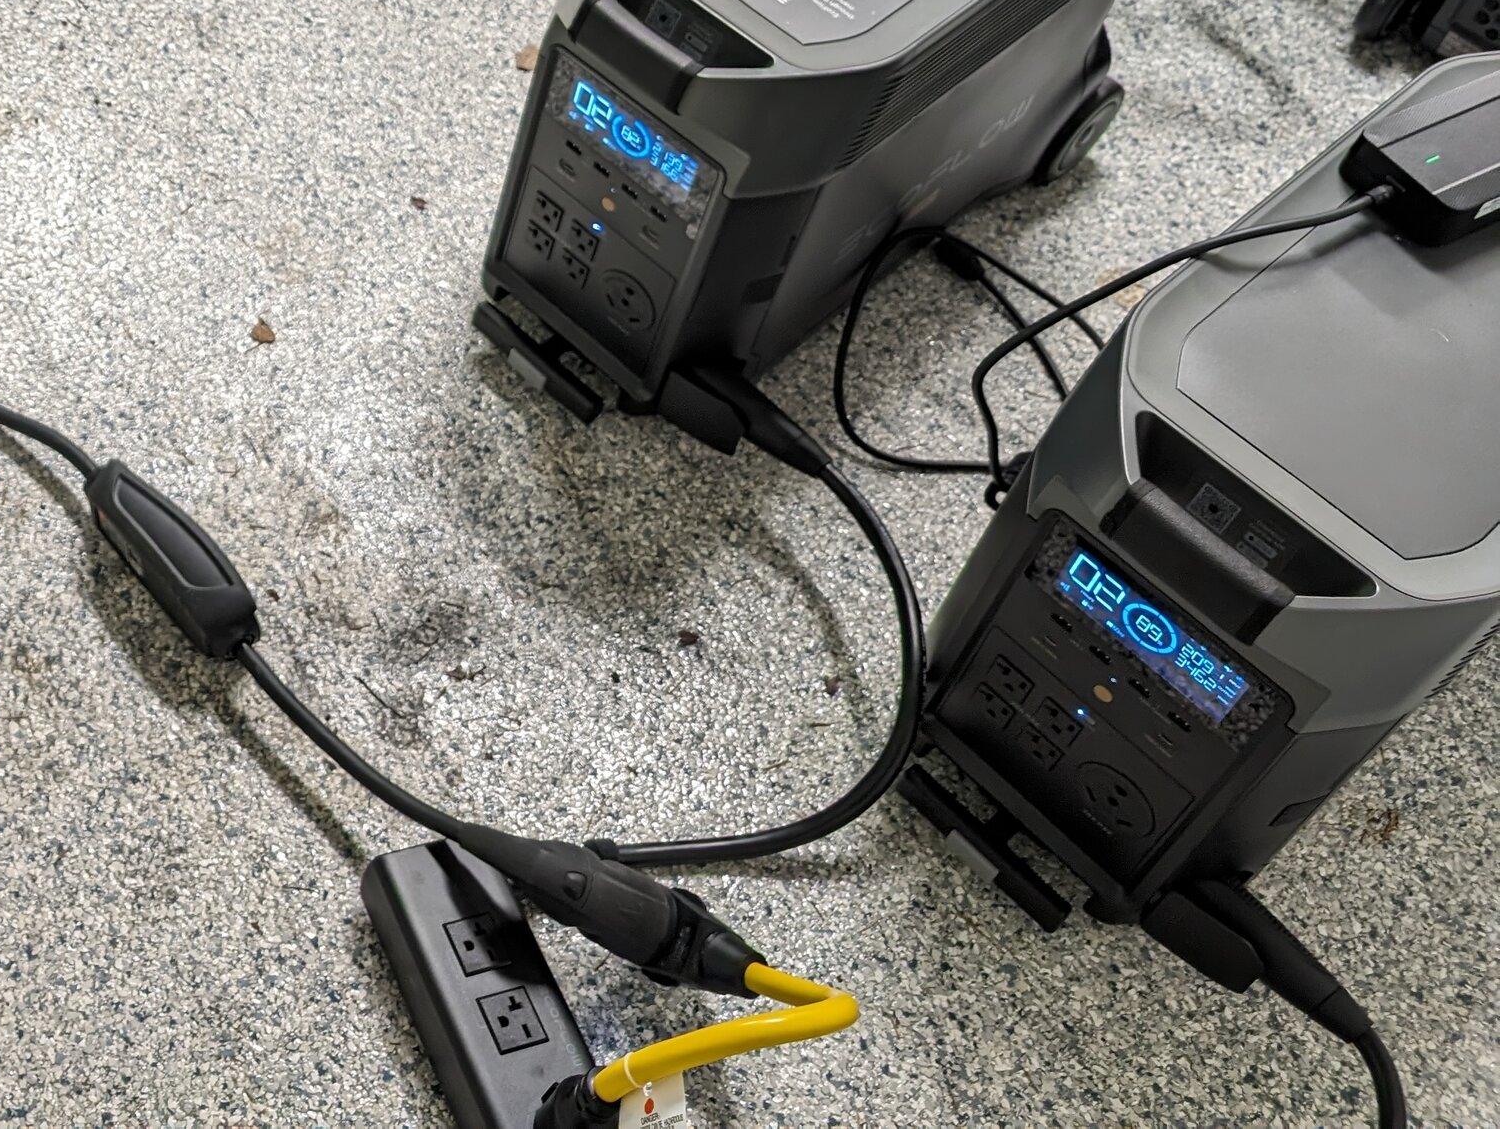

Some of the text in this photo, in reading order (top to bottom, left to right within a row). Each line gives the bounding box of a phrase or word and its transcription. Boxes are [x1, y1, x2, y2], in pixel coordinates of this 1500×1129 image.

[573, 81, 613, 129] 02
[1068, 553, 1126, 613] 02
[1174, 652, 1217, 692] 3462
